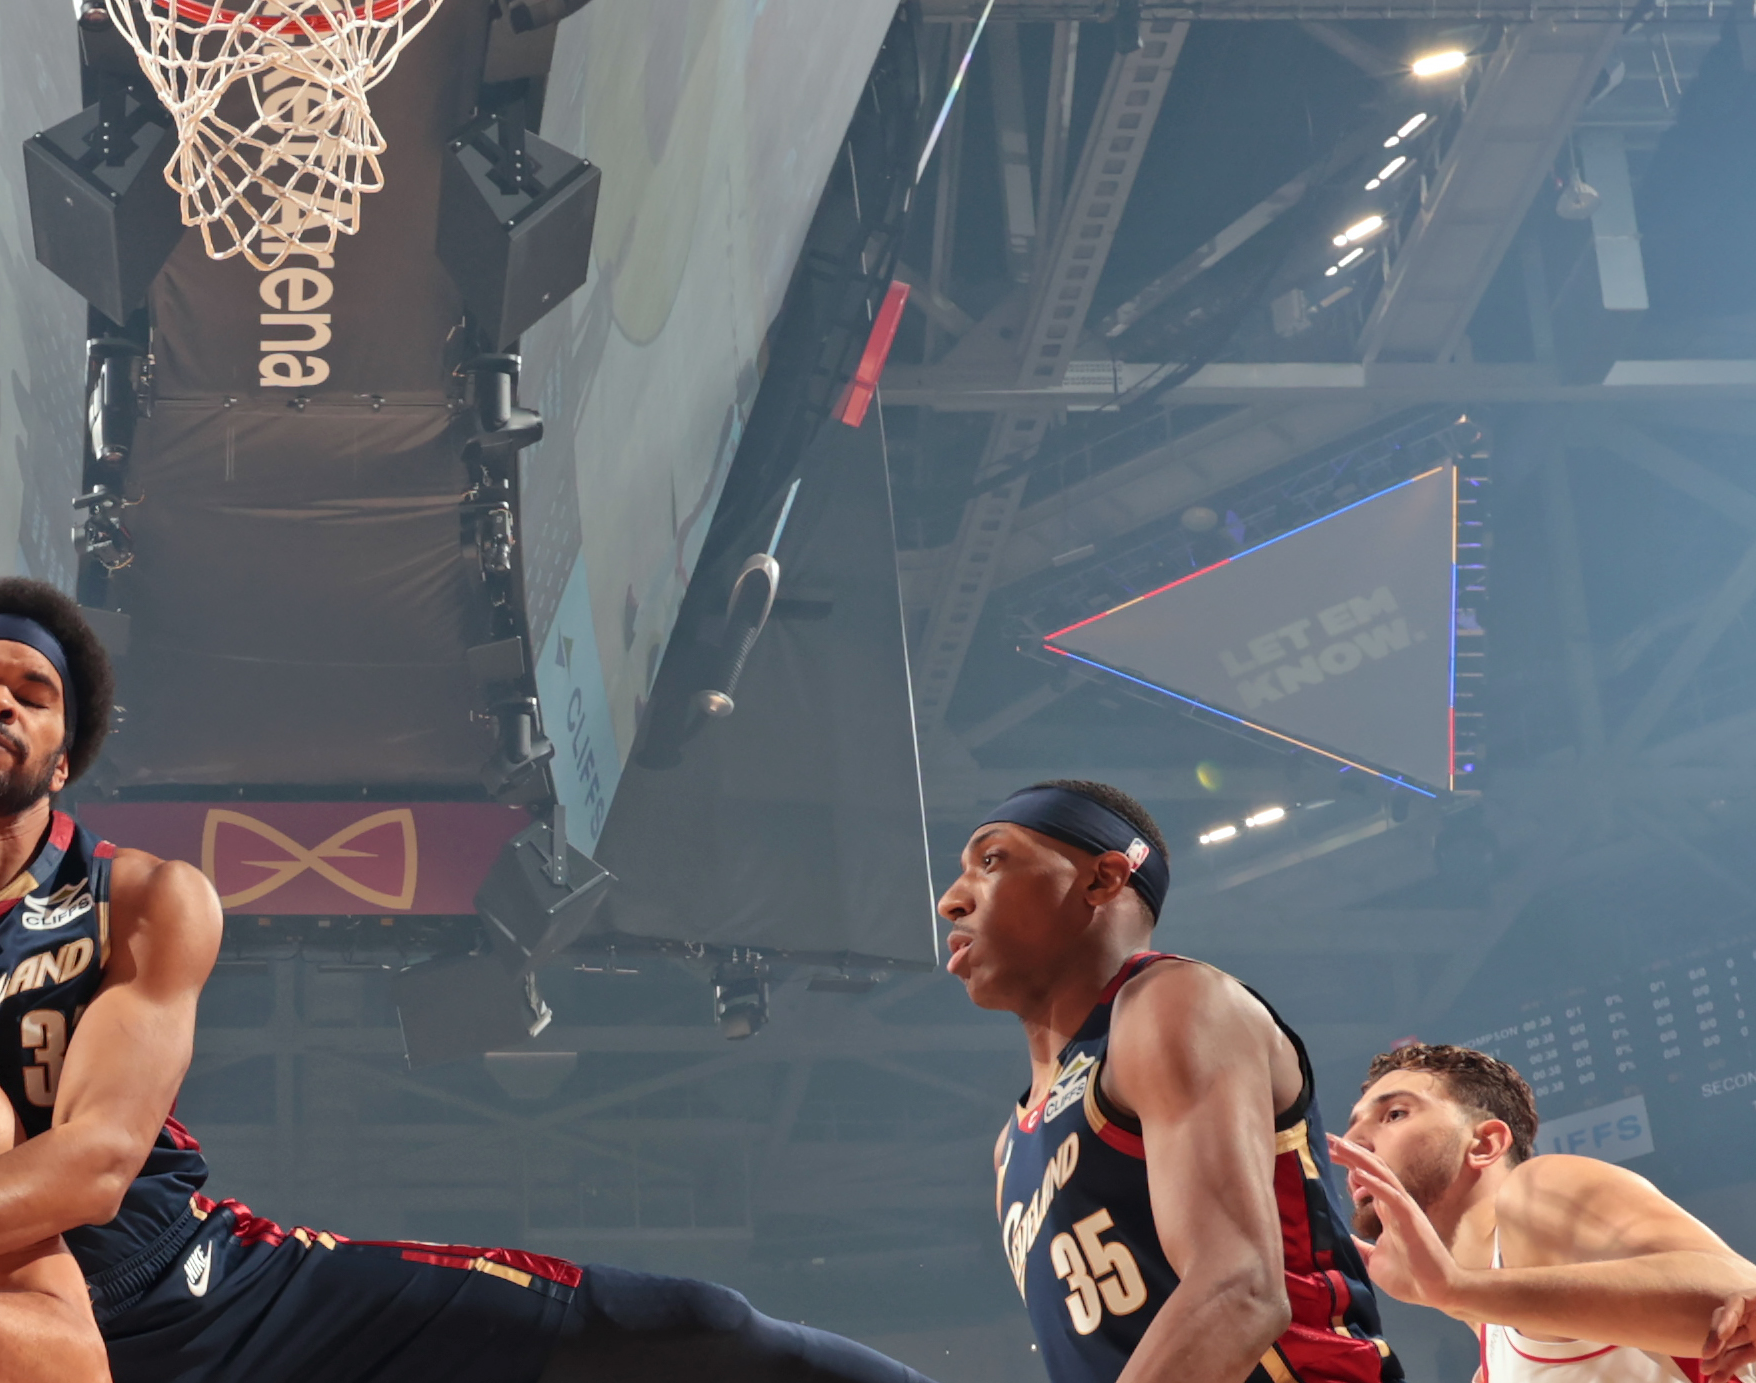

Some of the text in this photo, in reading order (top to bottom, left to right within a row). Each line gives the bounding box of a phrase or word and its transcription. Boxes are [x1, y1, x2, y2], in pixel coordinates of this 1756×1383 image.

[1219, 585, 1399, 678] LET EM
[564, 686, 606, 842] CLIFFS
[24, 896, 92, 926] CLIFFS
[20, 1005, 86, 1108] 3
[1045, 1077, 1088, 1118] CLIFFS
[1701, 1072, 1756, 1098] SECON
[1533, 1114, 1643, 1156] IFFS
[184, 1244, 207, 1285] NIKE
[1050, 1207, 1148, 1336] 35
